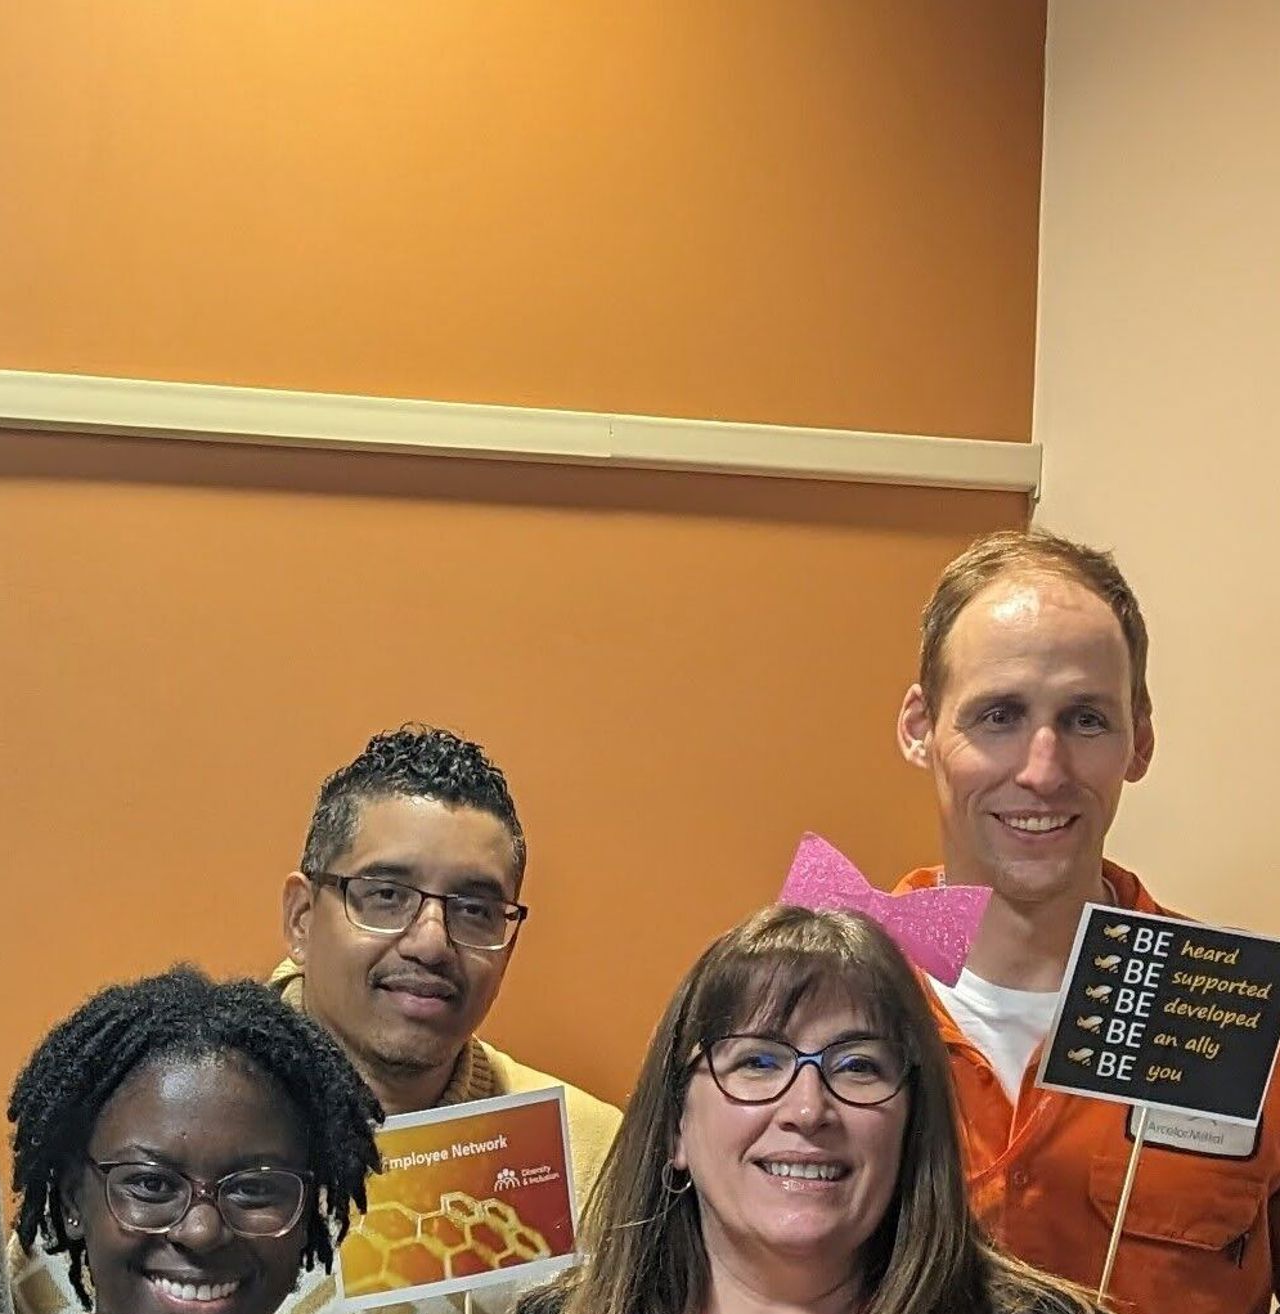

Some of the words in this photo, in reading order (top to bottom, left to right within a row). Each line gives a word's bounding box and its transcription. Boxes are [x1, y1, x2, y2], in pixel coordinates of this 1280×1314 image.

[1132, 927, 1174, 958] BE
[1180, 940, 1240, 966] heard
[1123, 958, 1165, 988] BE
[1171, 969, 1273, 1001] supported
[1114, 988, 1156, 1018] BE
[1163, 998, 1261, 1030] developed
[1105, 1019, 1147, 1049] BE
[1153, 1032, 1178, 1048] an
[1184, 1035, 1221, 1060] ally
[1096, 1051, 1137, 1081] BE
[1145, 1063, 1183, 1084] you
[451, 1135, 508, 1158] Network
